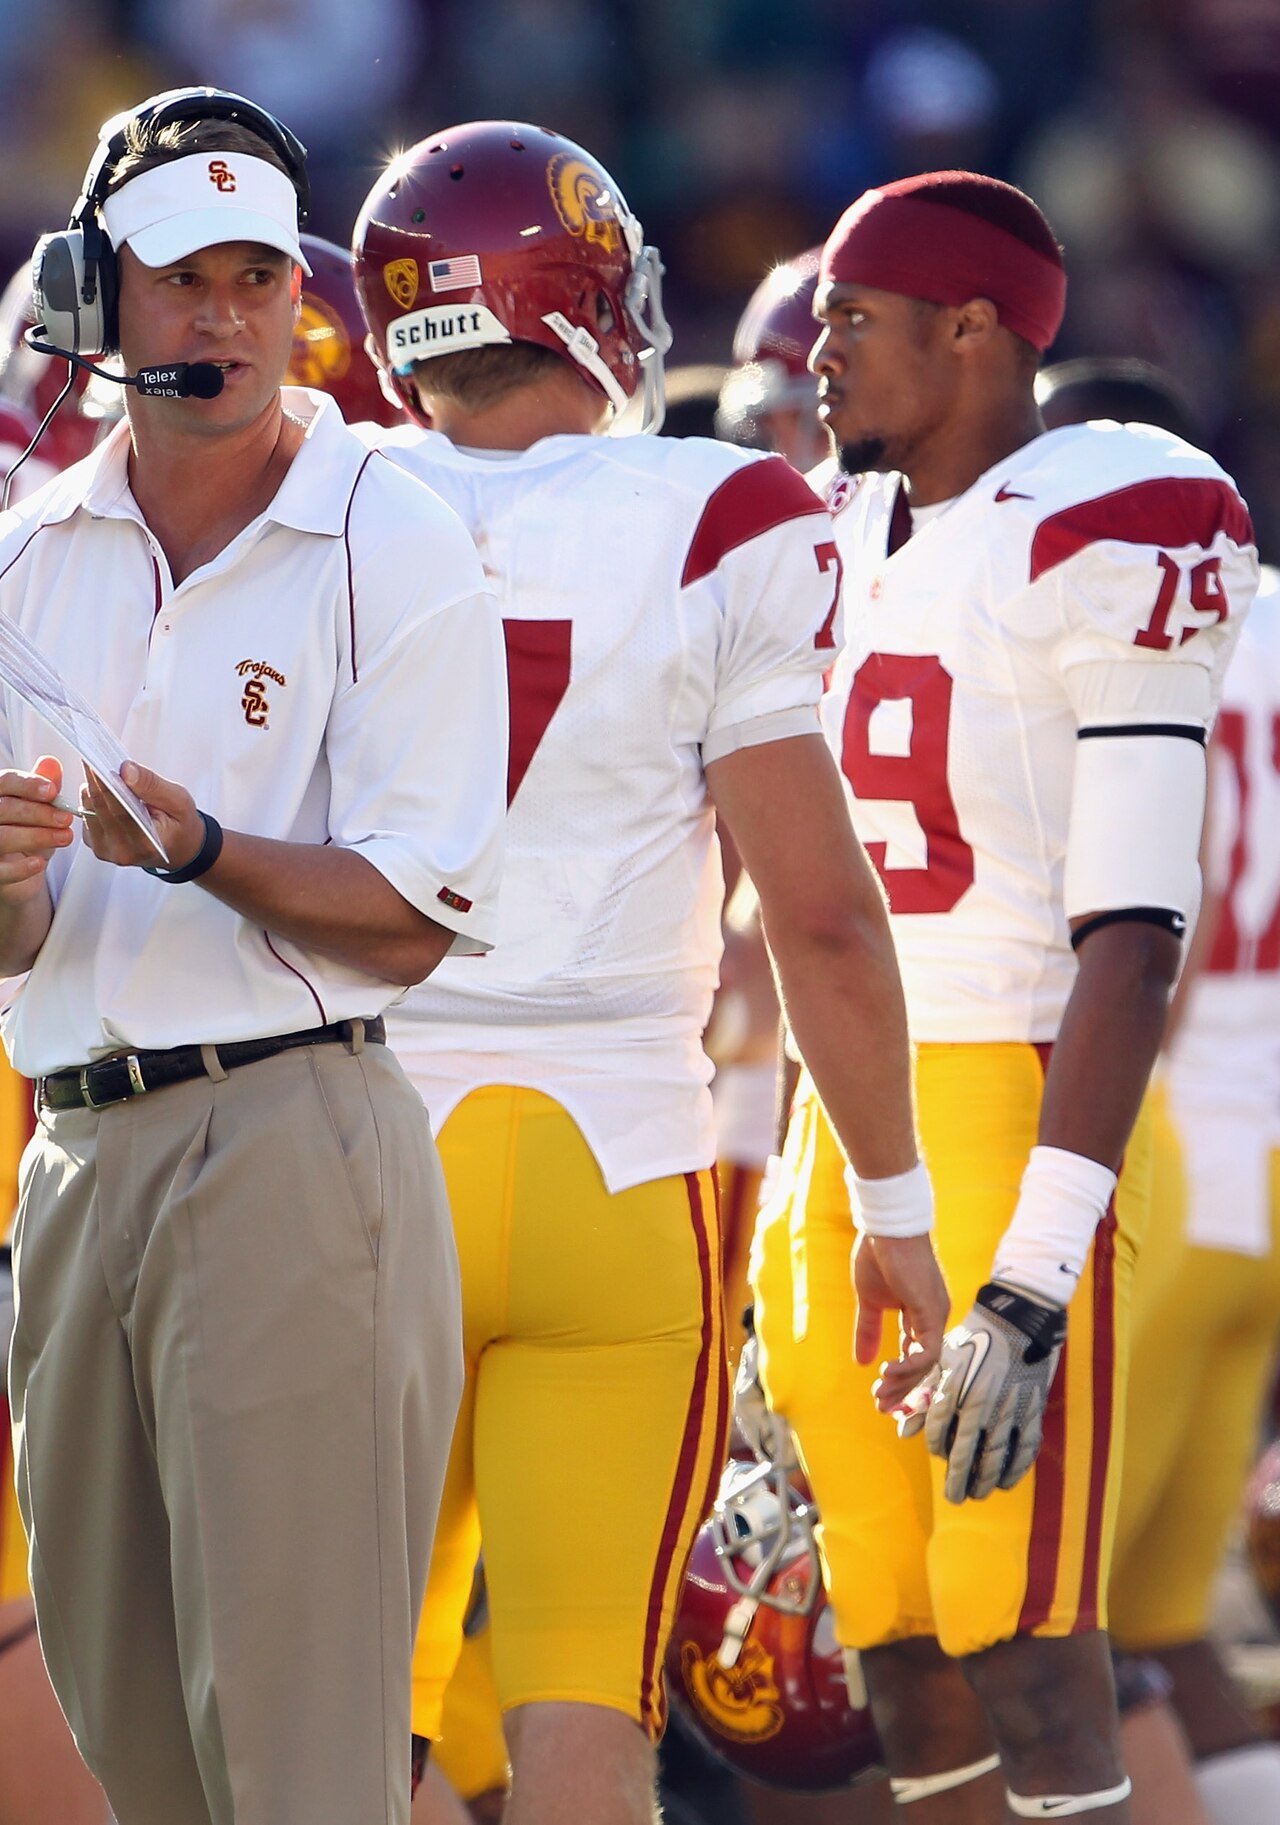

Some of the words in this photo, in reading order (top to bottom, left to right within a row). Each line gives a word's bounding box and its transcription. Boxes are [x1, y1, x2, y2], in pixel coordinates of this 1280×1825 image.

[395, 311, 481, 348] schutt
[140, 370, 178, 385] Telex
[145, 387, 182, 399] Telex
[814, 541, 844, 649] 7
[1133, 551, 1229, 651] 19
[234, 658, 286, 687] Trojans
[820, 652, 974, 914] 9
